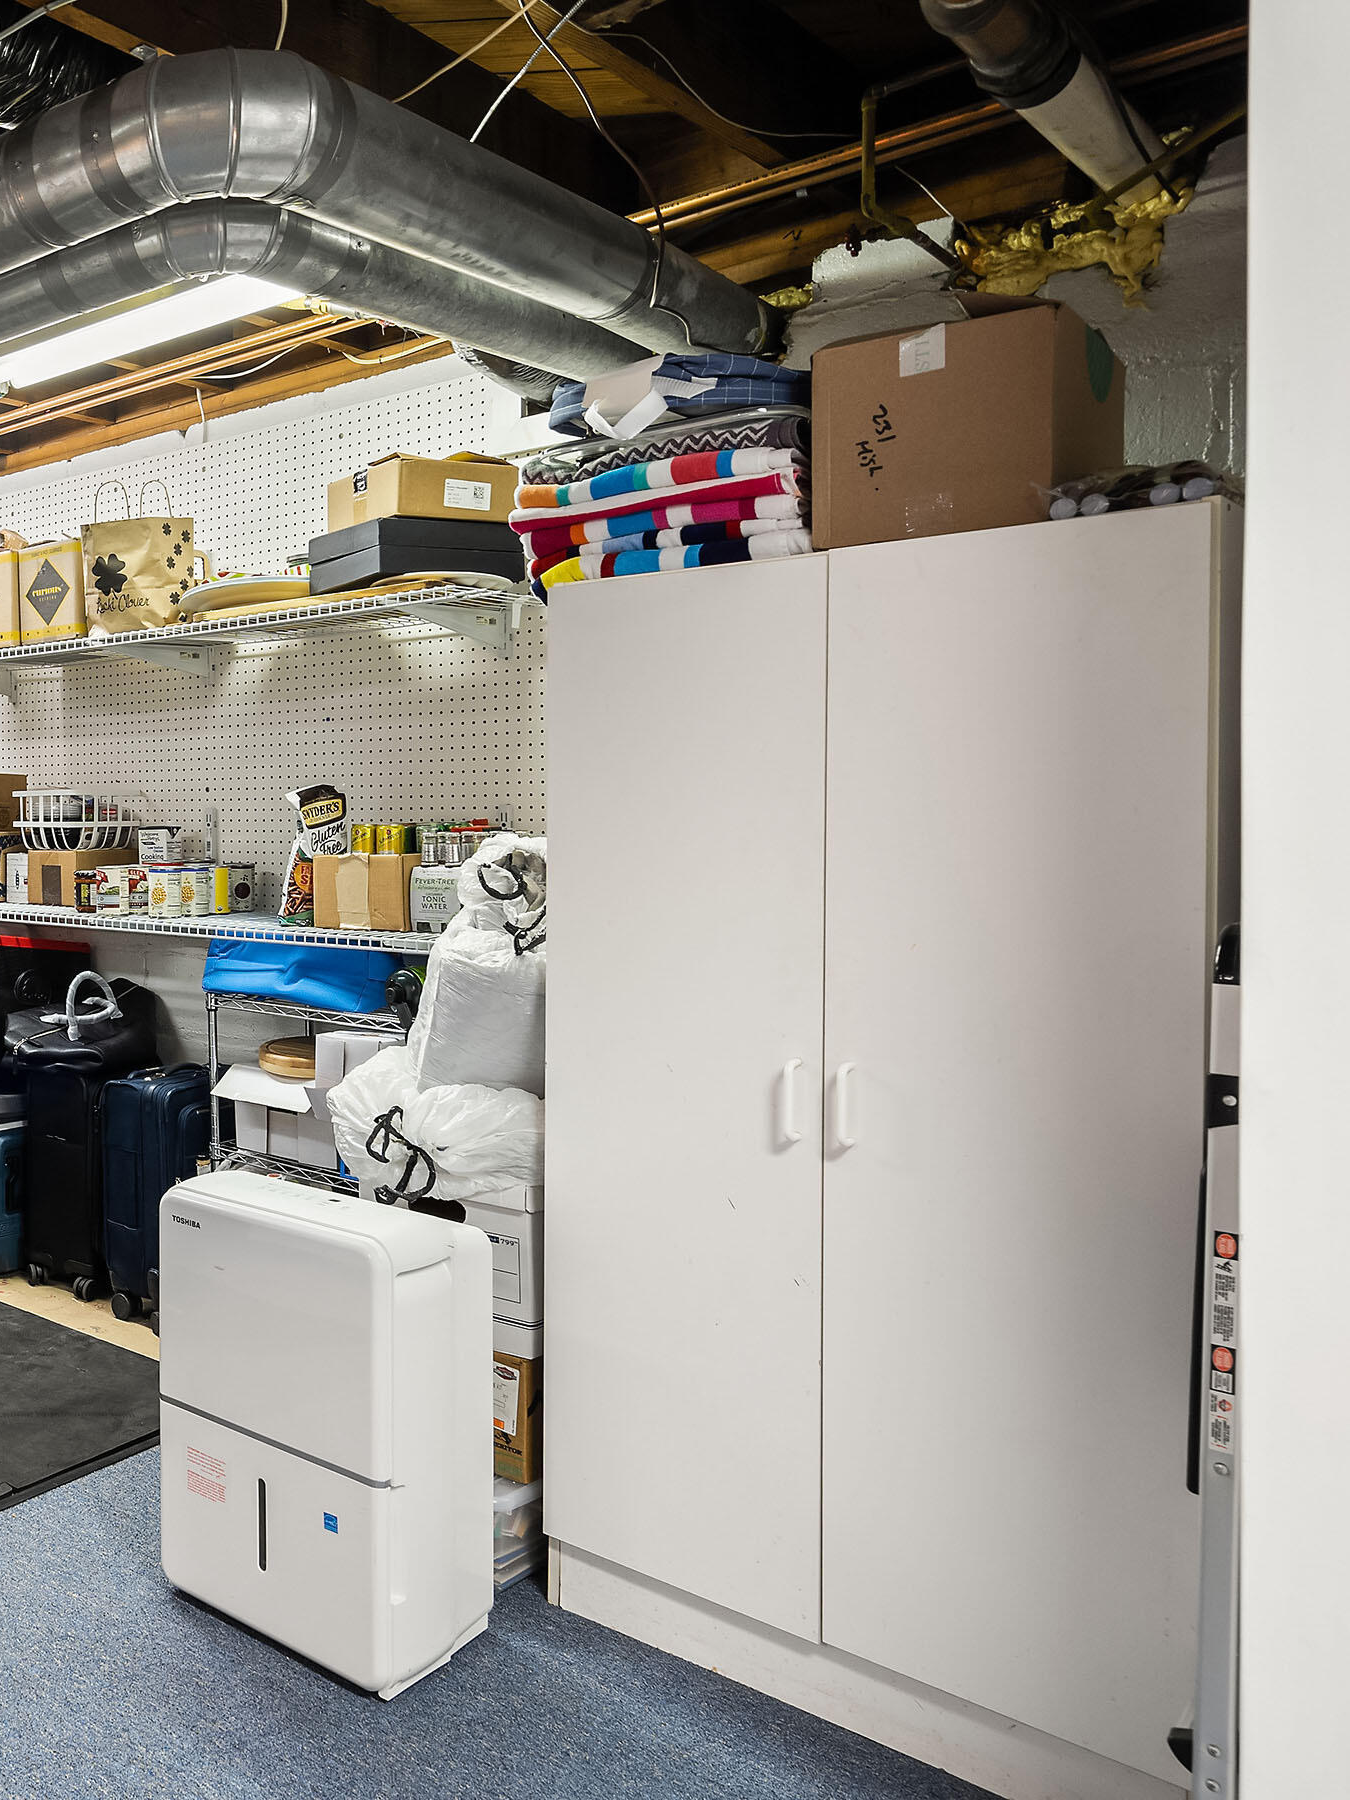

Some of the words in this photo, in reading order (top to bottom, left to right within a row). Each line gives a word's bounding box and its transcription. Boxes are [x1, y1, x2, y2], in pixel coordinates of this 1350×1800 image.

[117, 593, 151, 612] Clover
[301, 800, 341, 821] SNYDER'S
[310, 821, 347, 853] Gluten
[421, 895, 446, 903] TONIC
[171, 1214, 202, 1230] TOSHIBA
